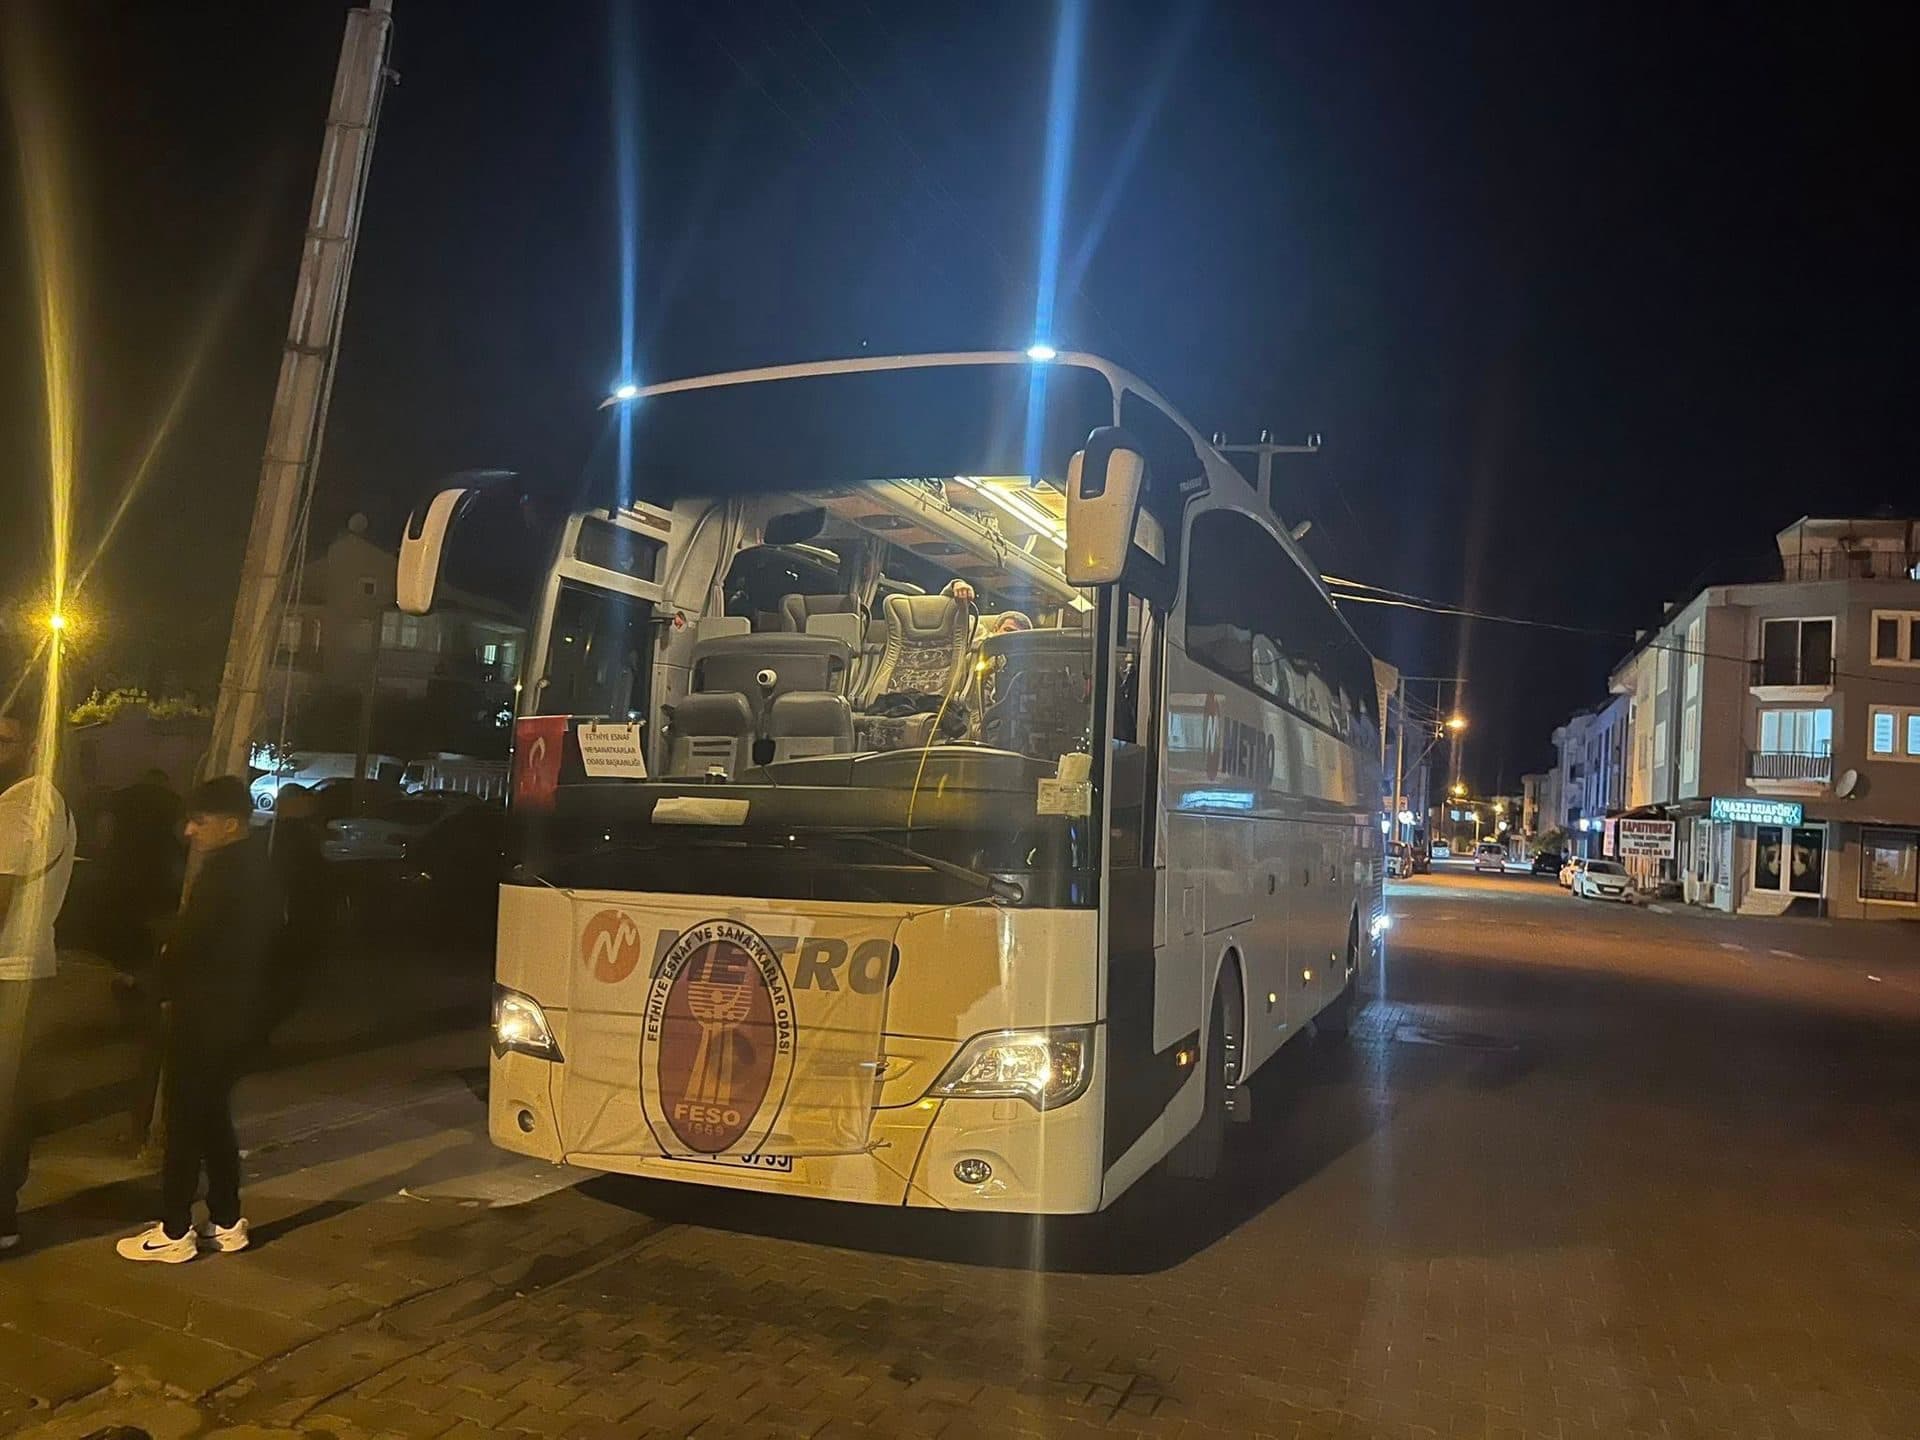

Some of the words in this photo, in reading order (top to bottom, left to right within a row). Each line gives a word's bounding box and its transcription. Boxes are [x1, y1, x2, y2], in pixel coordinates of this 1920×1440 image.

[610, 733, 630, 741] ESNAF
[662, 937, 694, 981] ESNAF
[695, 926, 713, 940] VE
[716, 924, 787, 1005] SANATKARLAR
[776, 1008, 791, 1055] ODASI
[674, 1103, 741, 1127] FESO
